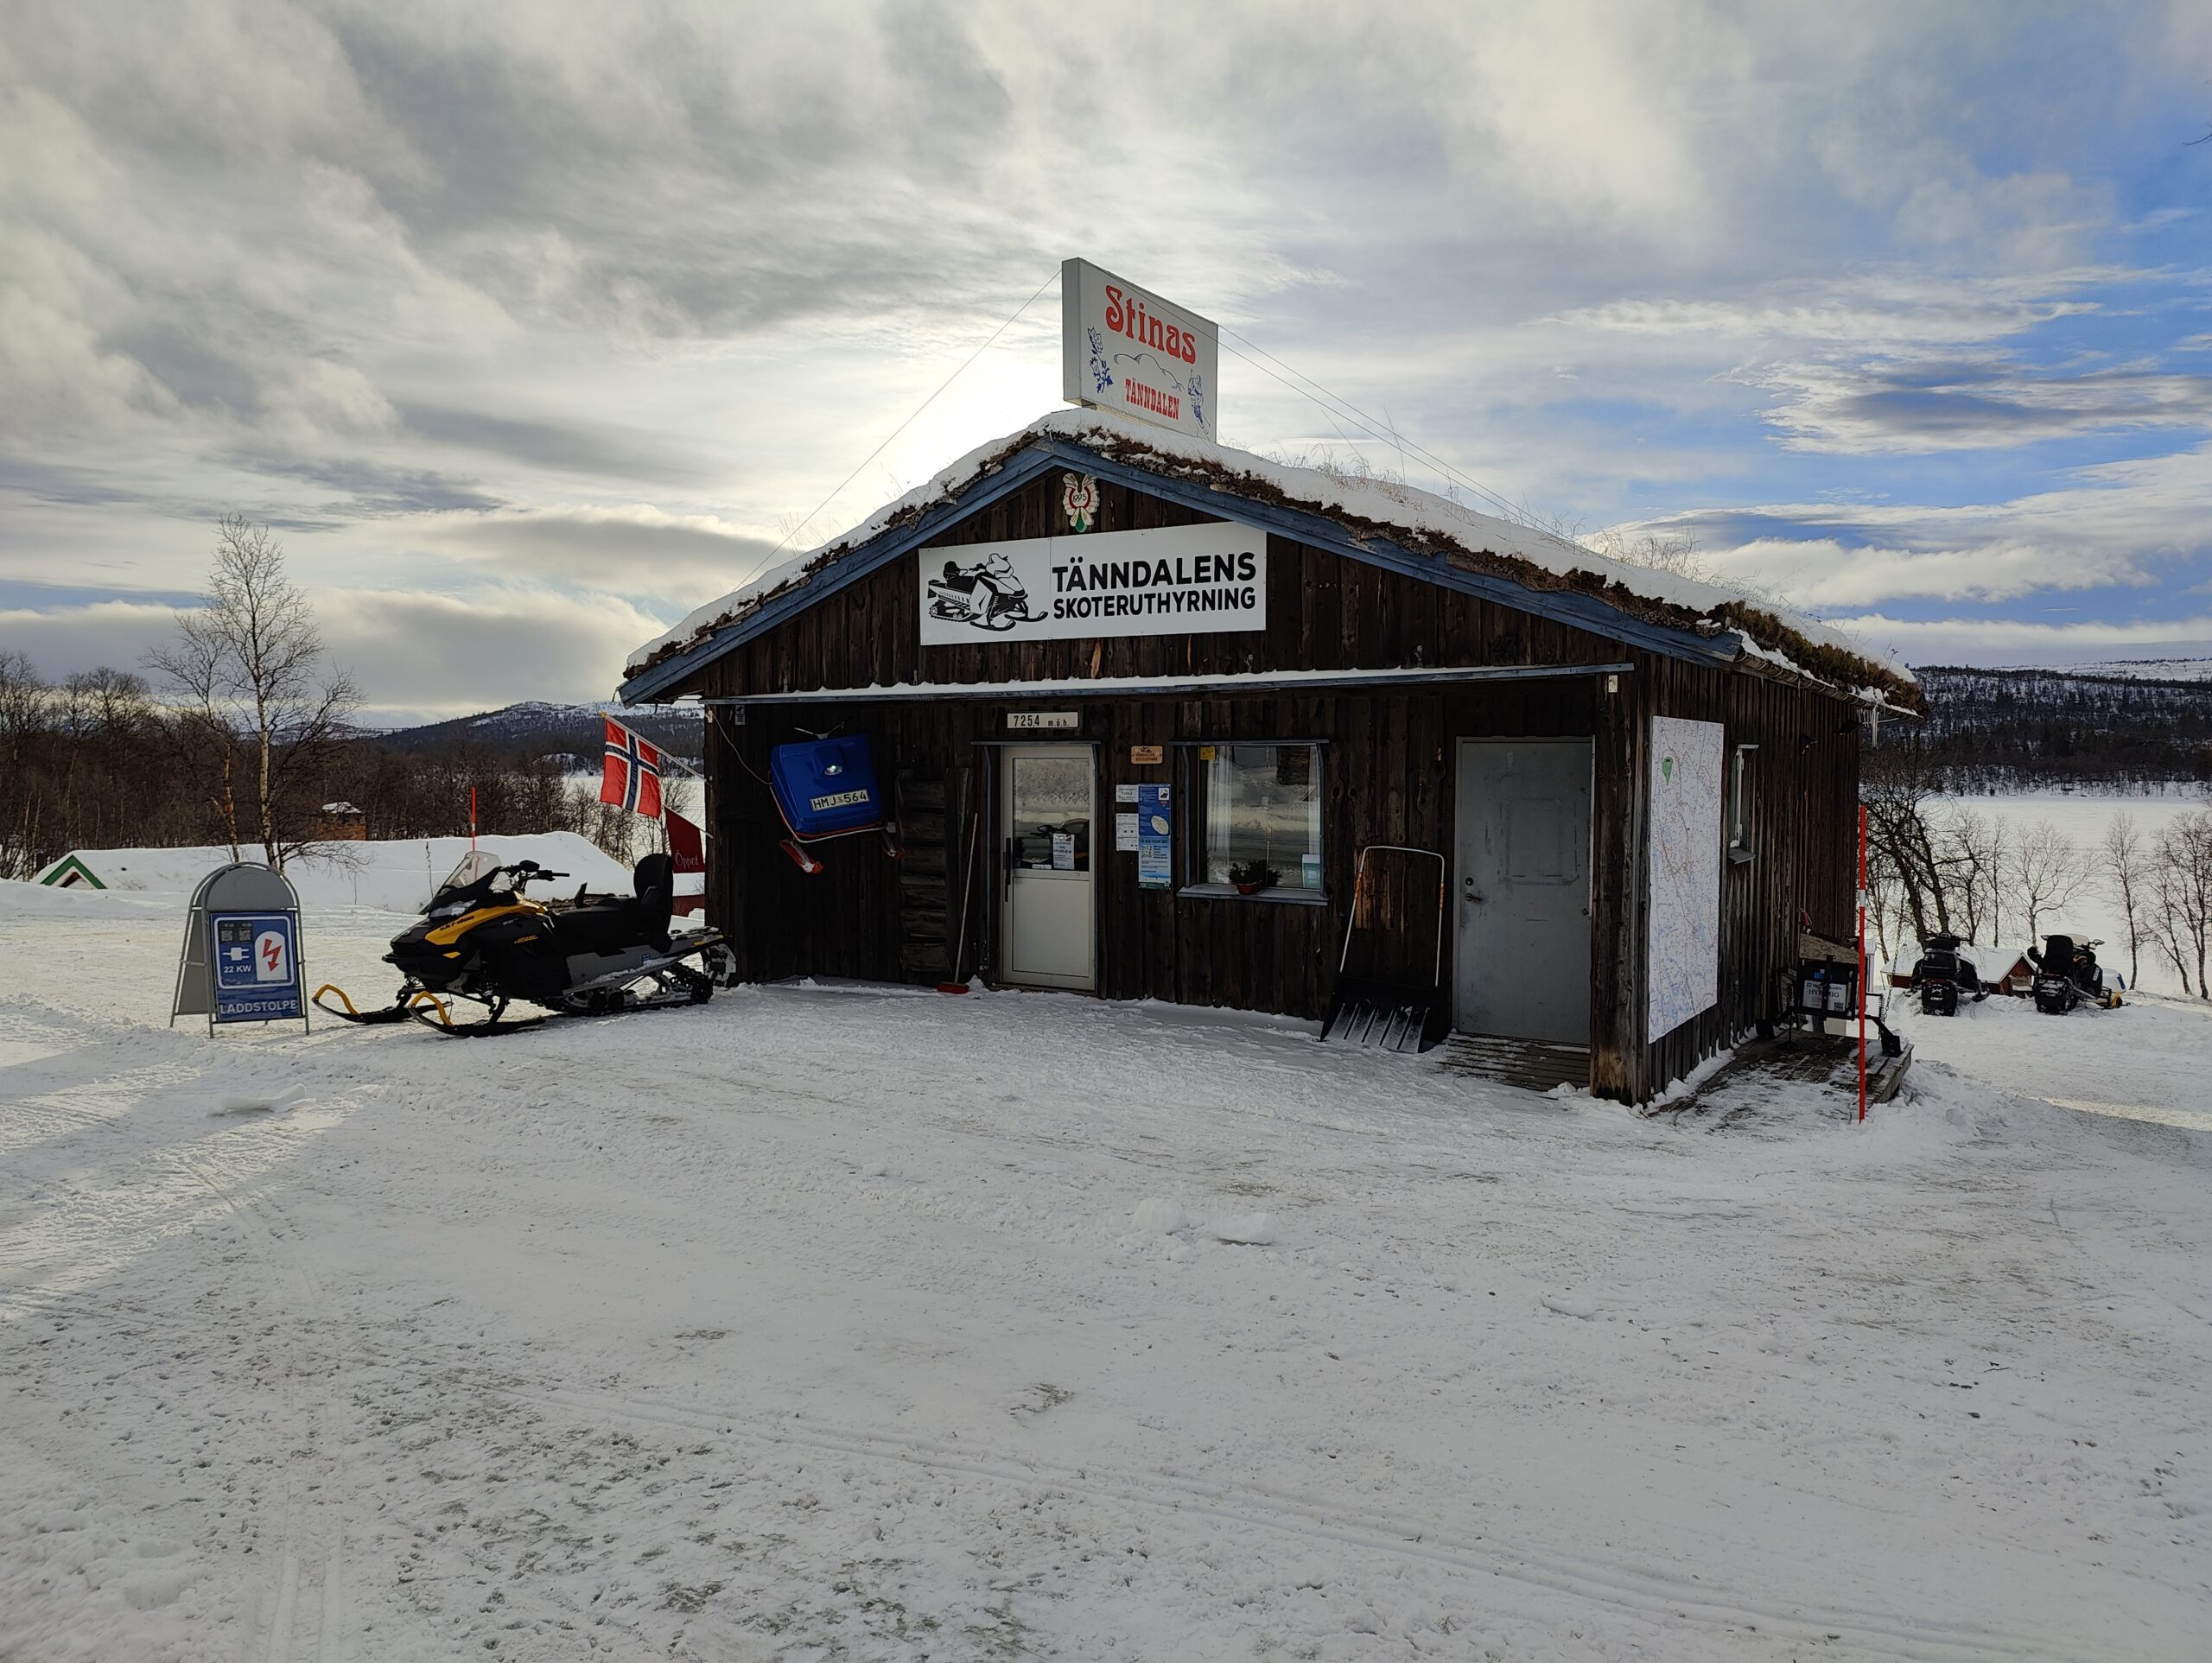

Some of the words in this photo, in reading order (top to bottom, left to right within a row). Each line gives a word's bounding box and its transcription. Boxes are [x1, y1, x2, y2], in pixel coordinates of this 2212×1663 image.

[1106, 285, 1196, 365] Stinas
[1125, 378, 1180, 421] TÄNNDALEN
[1052, 552, 1256, 592] TÄNNDALENS
[1053, 587, 1256, 619] SKOTERUTHYRNING
[813, 797, 836, 809] HMJ
[843, 792, 867, 803] 564
[675, 850, 699, 869] Öppet
[220, 1000, 296, 1013] LADDSTOLPE
